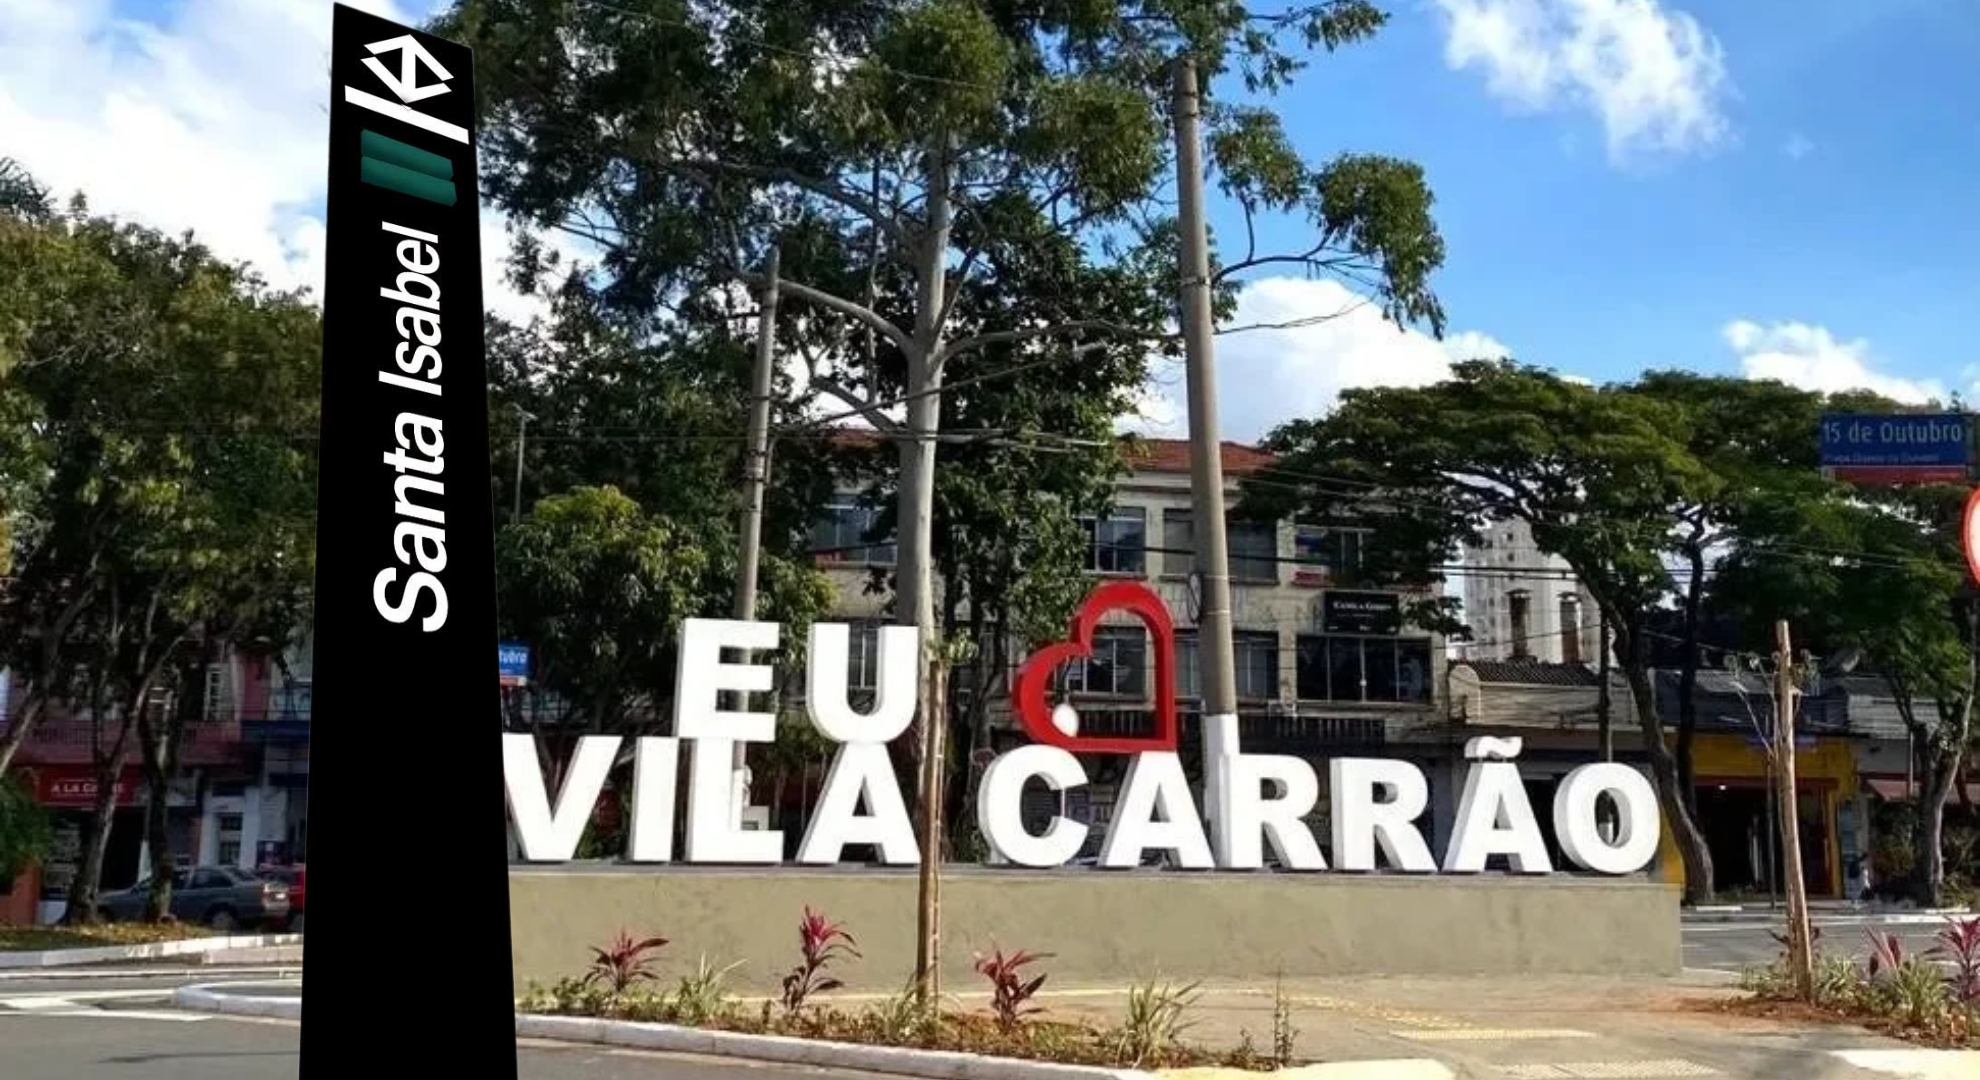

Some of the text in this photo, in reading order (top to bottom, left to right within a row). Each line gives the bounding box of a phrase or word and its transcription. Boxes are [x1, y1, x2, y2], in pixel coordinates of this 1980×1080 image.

[373, 220, 449, 633] Santa Isabel
[1824, 419, 1962, 444] 15 de Outubro
[673, 617, 919, 743] EU
[502, 731, 1661, 874] VILA CARRÃO
